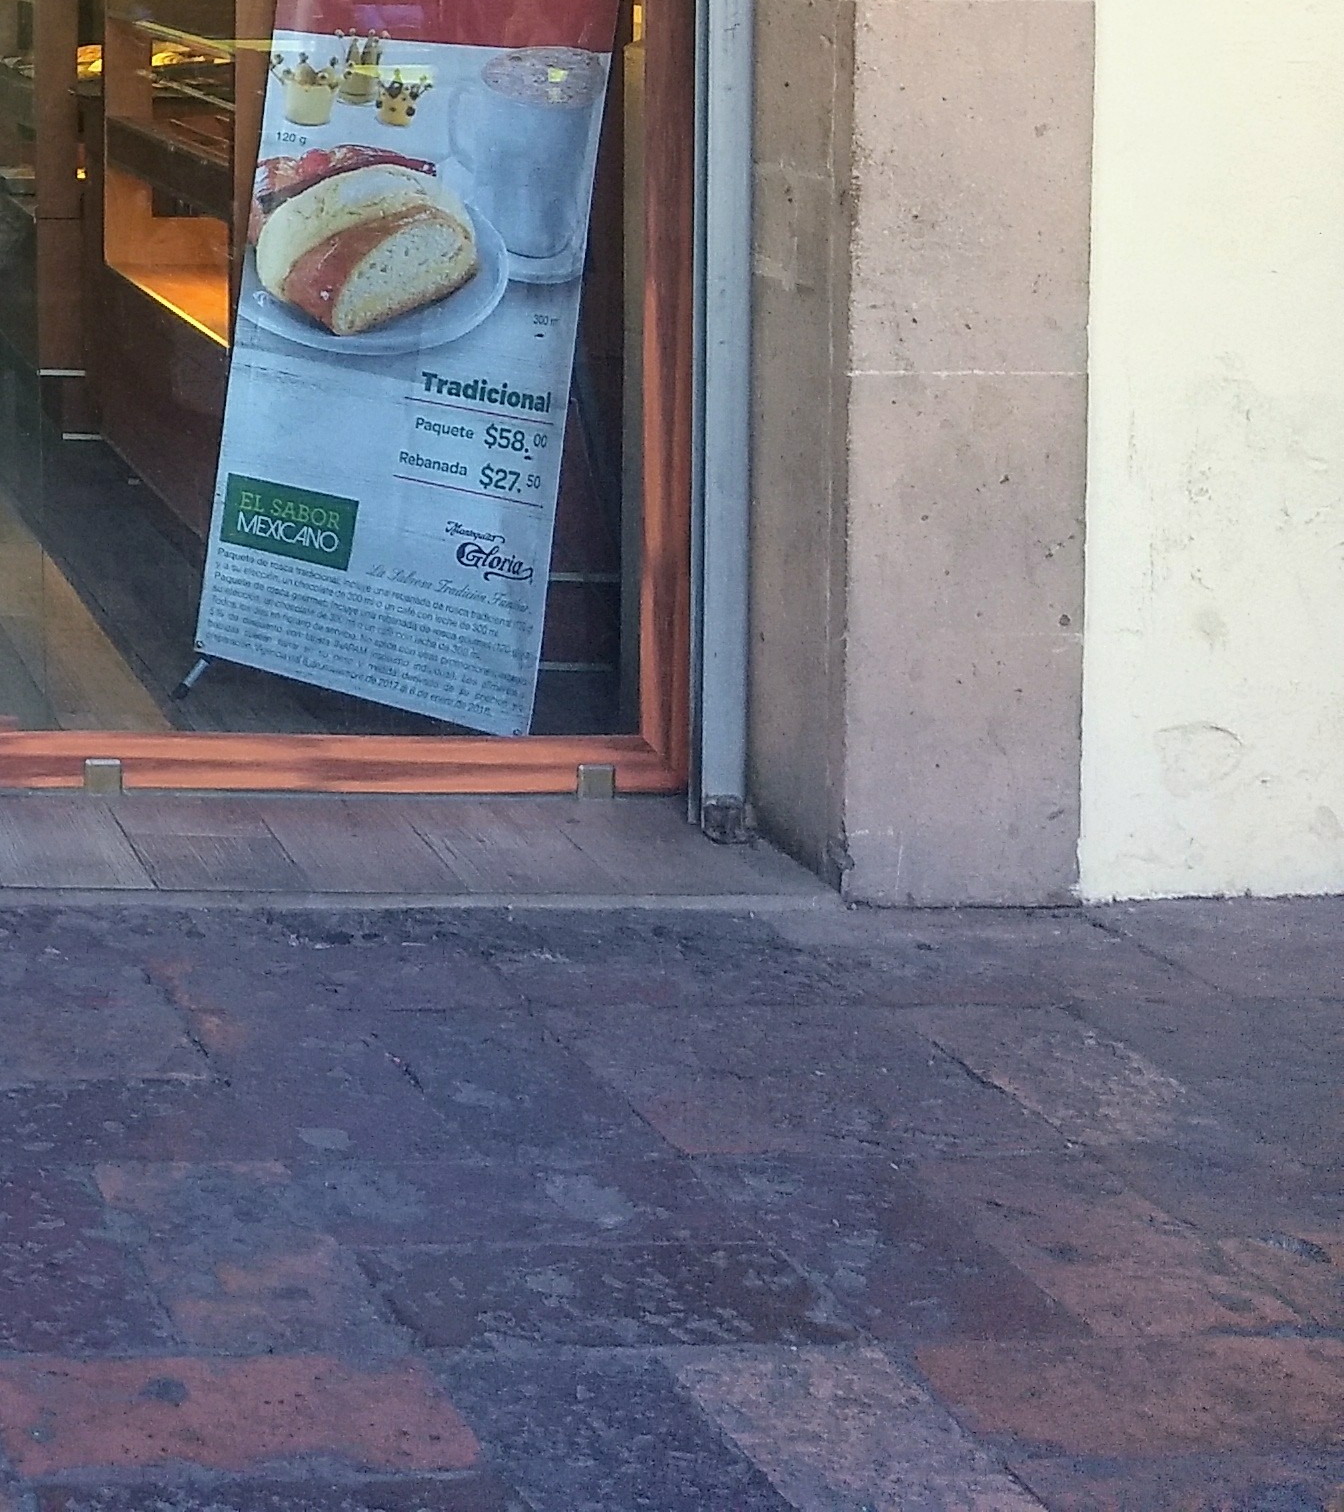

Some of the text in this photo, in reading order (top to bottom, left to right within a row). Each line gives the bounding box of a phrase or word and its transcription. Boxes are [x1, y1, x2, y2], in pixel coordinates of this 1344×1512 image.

[277, 132, 307, 146] 120 g
[533, 314, 548, 326] 300
[422, 371, 552, 413] Tradicional
[415, 417, 548, 454] Paquete $58. 00
[399, 451, 541, 493] Rebanada $27. 50
[239, 491, 341, 530] EL SABOR
[237, 511, 339, 553] MEXICANO
[456, 541, 534, 584] Gloria
